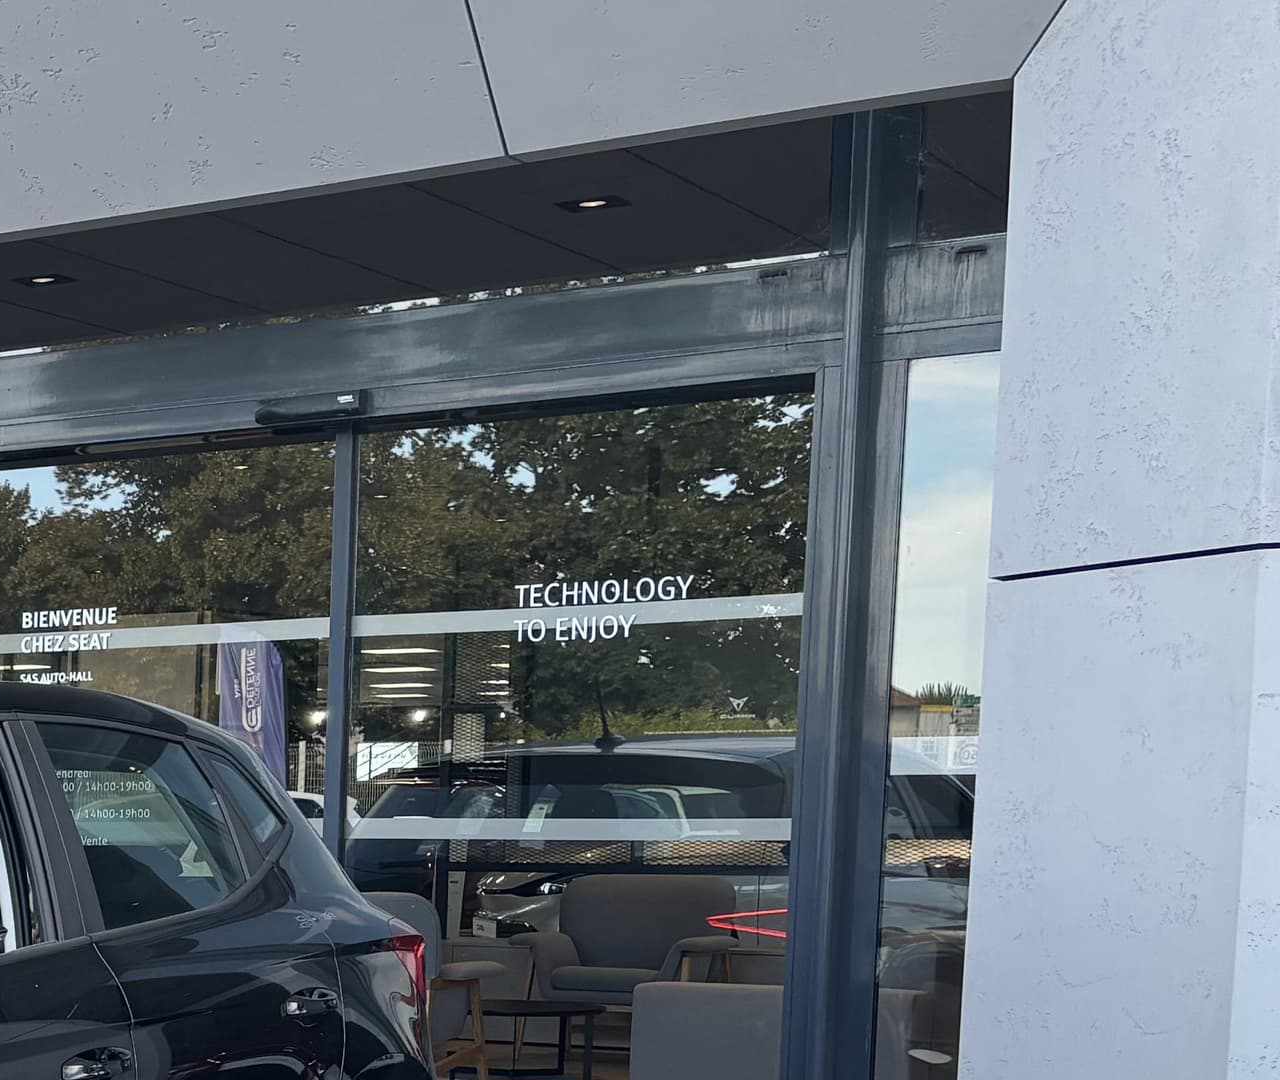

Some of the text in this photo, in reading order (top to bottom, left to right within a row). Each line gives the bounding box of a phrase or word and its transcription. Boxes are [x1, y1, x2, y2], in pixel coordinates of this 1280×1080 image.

[515, 575, 694, 608] TECHNOLOGY
[22, 607, 117, 628] BIENVENUE
[513, 614, 637, 643] TO ENJOY
[21, 632, 111, 653] CHEZ SEAT
[20, 671, 93, 684] SAS AUTO-HALL
[86, 780, 152, 792] 14h00-19h00
[85, 808, 150, 819] 14h00-19h00
[81, 836, 108, 846] Vente
